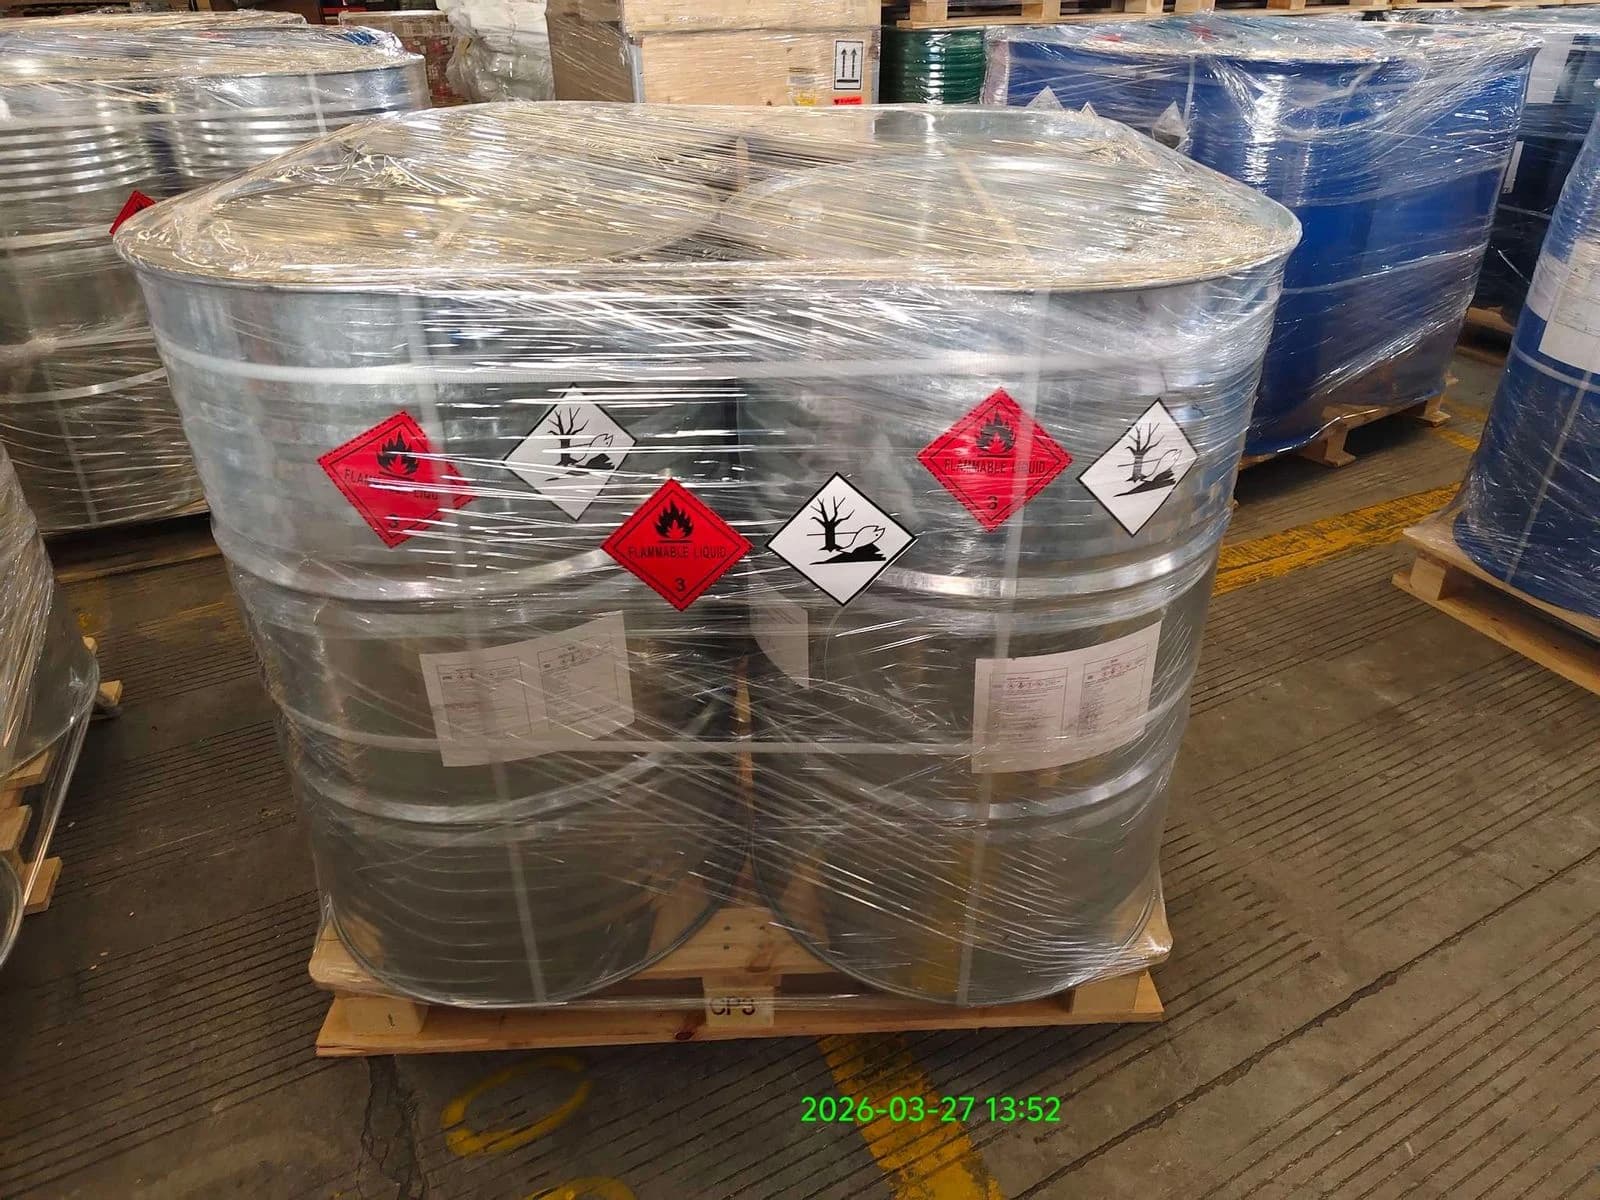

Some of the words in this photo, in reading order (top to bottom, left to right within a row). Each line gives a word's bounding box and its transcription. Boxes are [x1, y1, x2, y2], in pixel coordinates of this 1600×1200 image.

[944, 459, 1005, 474] FLAMMABLE
[987, 496, 998, 510] 3
[389, 514, 400, 529] 3
[628, 546, 689, 559] FLAMMABLE
[693, 546, 727, 559] LIQUID
[676, 577, 686, 592] 3
